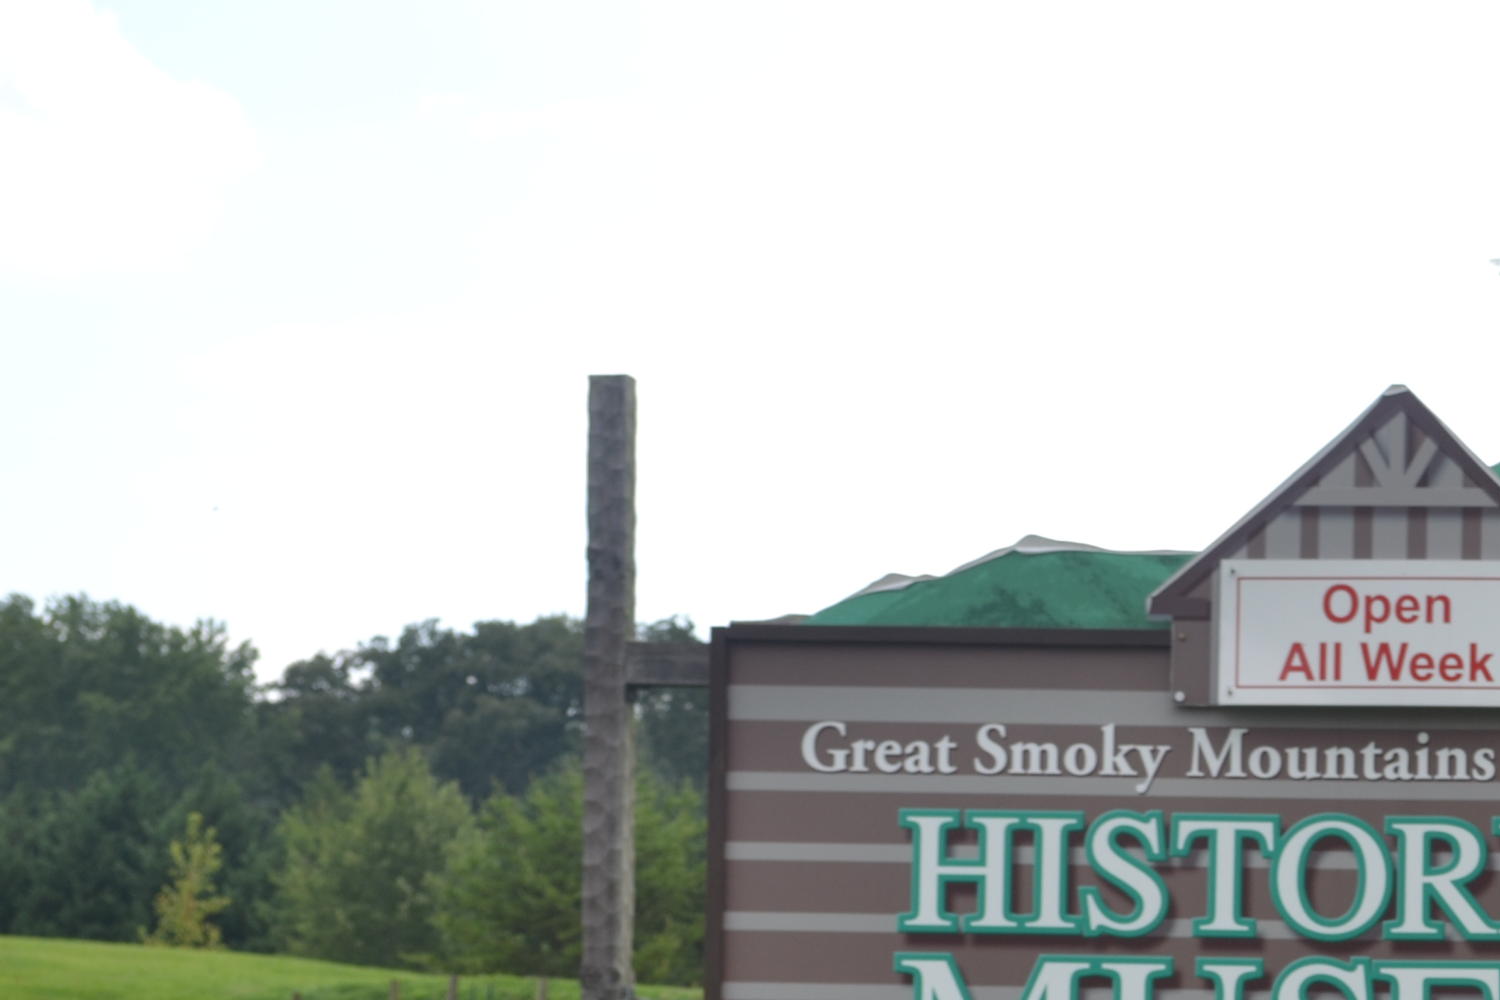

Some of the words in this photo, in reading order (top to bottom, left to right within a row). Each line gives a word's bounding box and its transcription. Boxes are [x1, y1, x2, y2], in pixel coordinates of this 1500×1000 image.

[1322, 583, 1452, 634] Open
[1278, 642, 1342, 683] All
[1360, 642, 1495, 683] Week
[801, 720, 959, 775] Great
[974, 723, 1171, 795] Smoky
[1187, 728, 1497, 784] Mountains
